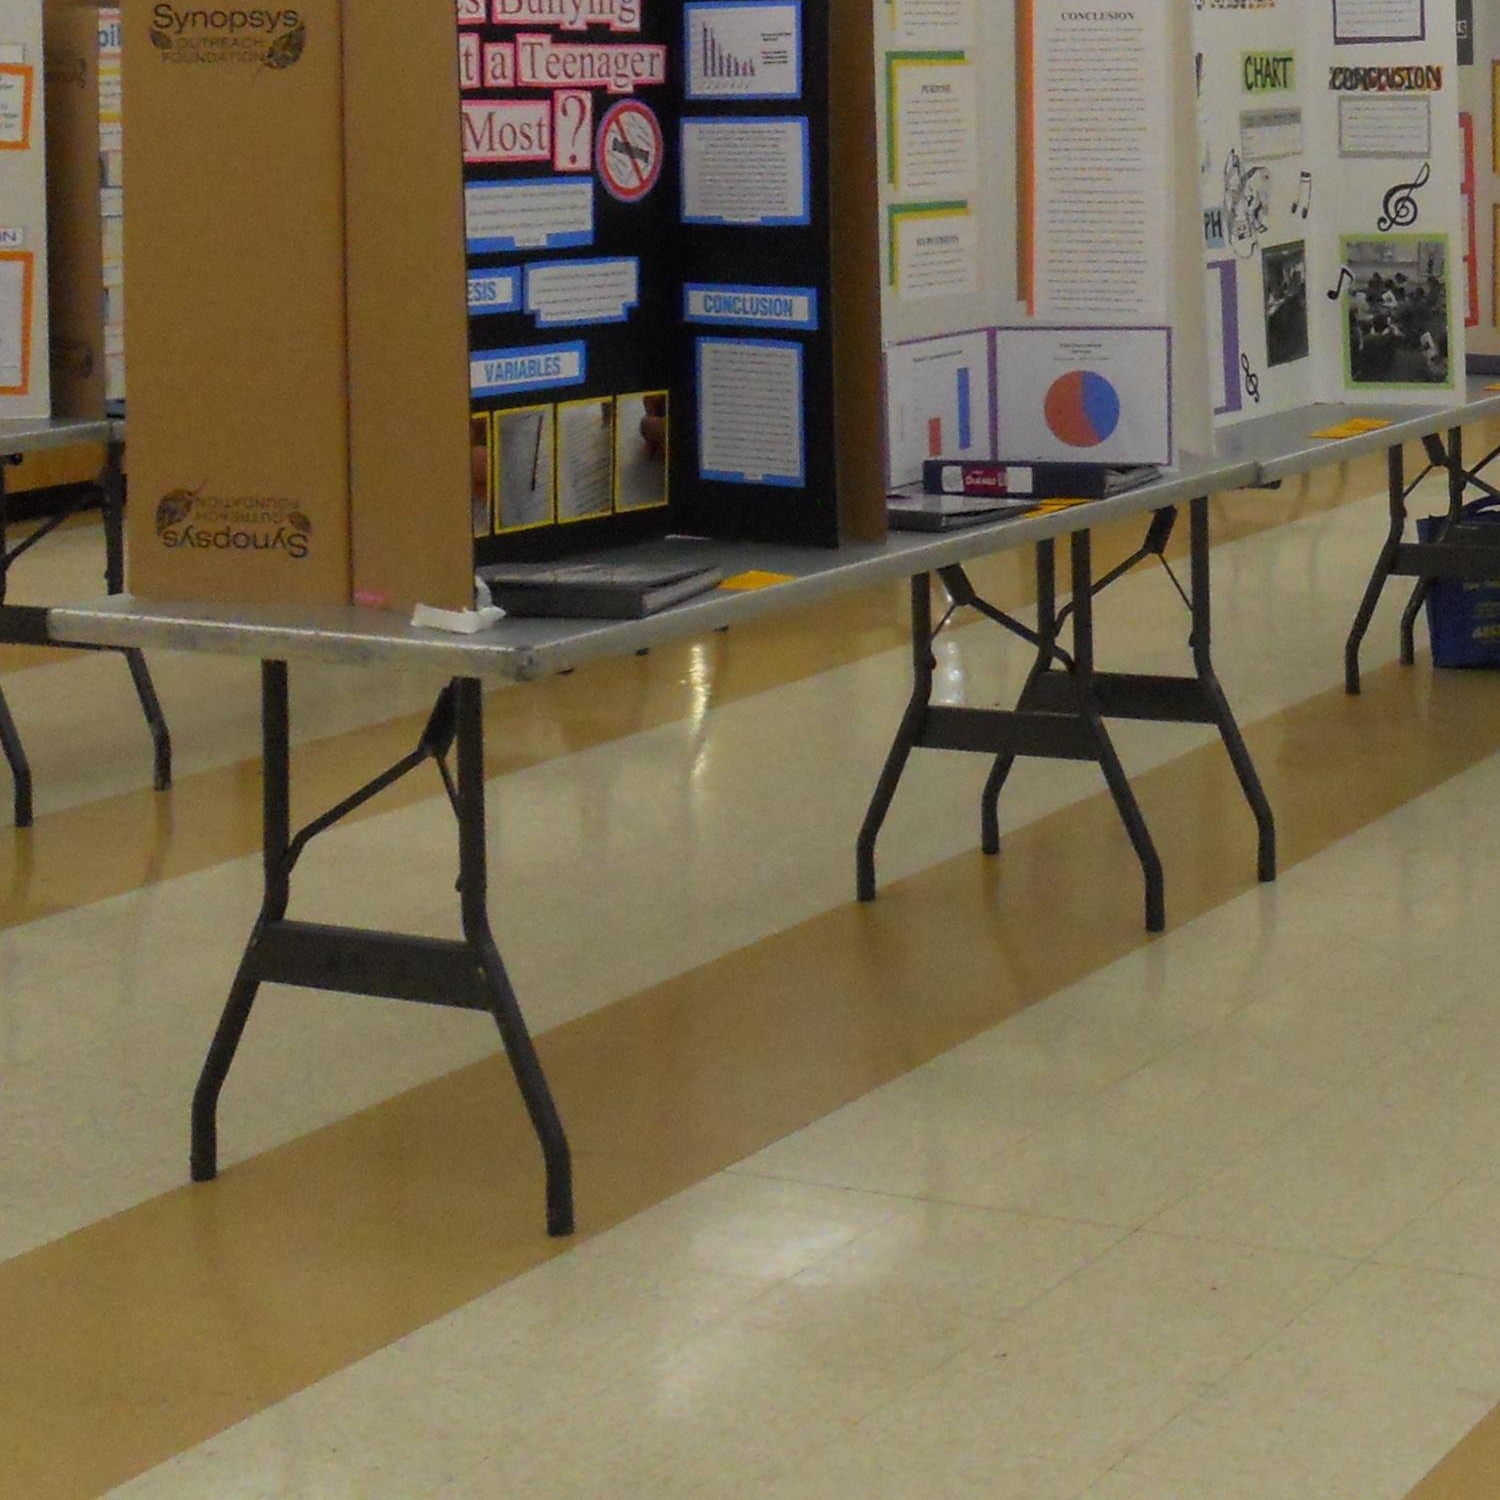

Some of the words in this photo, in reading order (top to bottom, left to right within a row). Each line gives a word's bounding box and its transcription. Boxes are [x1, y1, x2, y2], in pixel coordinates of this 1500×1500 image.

[153, 3, 299, 34] Synopsys
[1061, 11, 1135, 22] CONCLUSION
[491, 51, 507, 80] a
[522, 42, 661, 88] Teenager
[1244, 55, 1294, 91] CHART
[1330, 66, 1443, 92] CONCLUSION
[462, 111, 548, 152] Most
[560, 95, 586, 165] ?
[703, 294, 793, 317] CONCLUSION
[484, 356, 561, 383] VARIABLES
[162, 524, 309, 559] Synopsys
